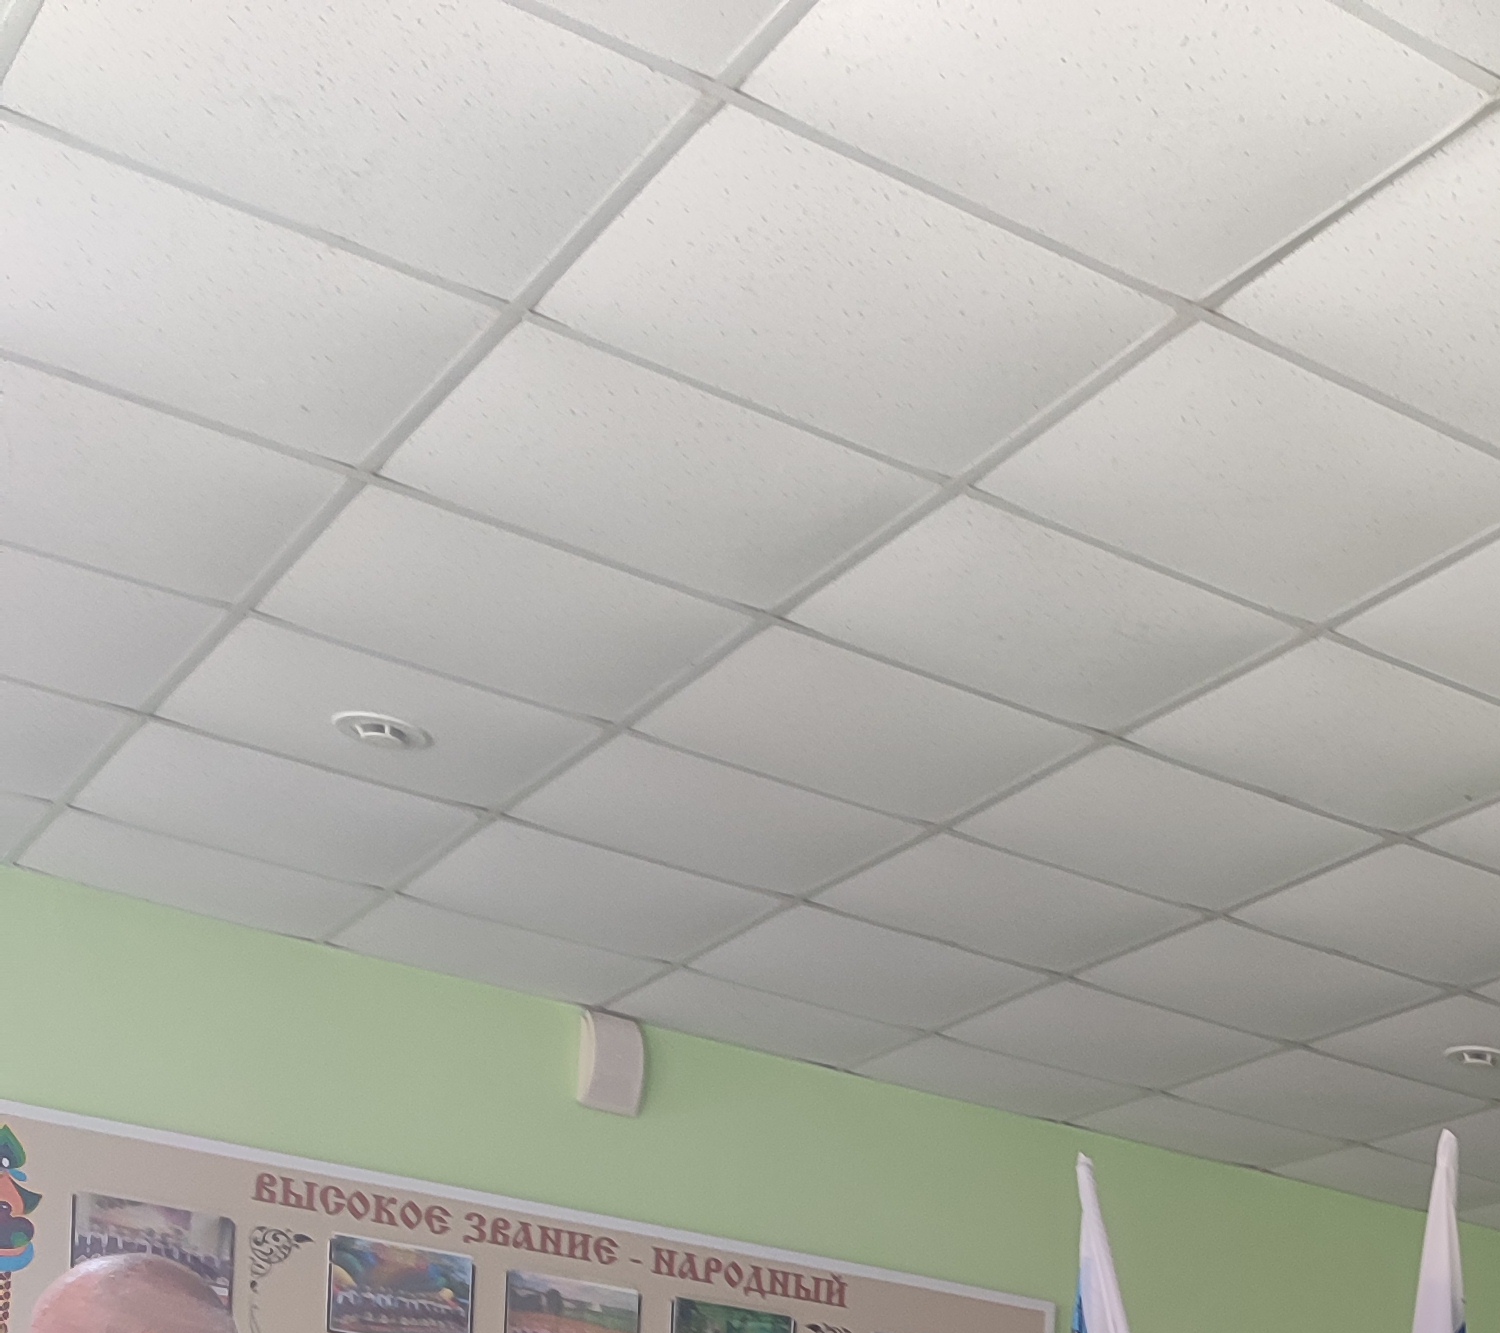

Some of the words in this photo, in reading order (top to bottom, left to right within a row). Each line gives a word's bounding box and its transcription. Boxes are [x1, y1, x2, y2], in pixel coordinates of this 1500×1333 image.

[252, 1172, 453, 1235] ВЫСОКОЕ
[462, 1212, 620, 1265] ЗВАНИЕ
[650, 1245, 848, 1309] НАРОДНЫЙ
